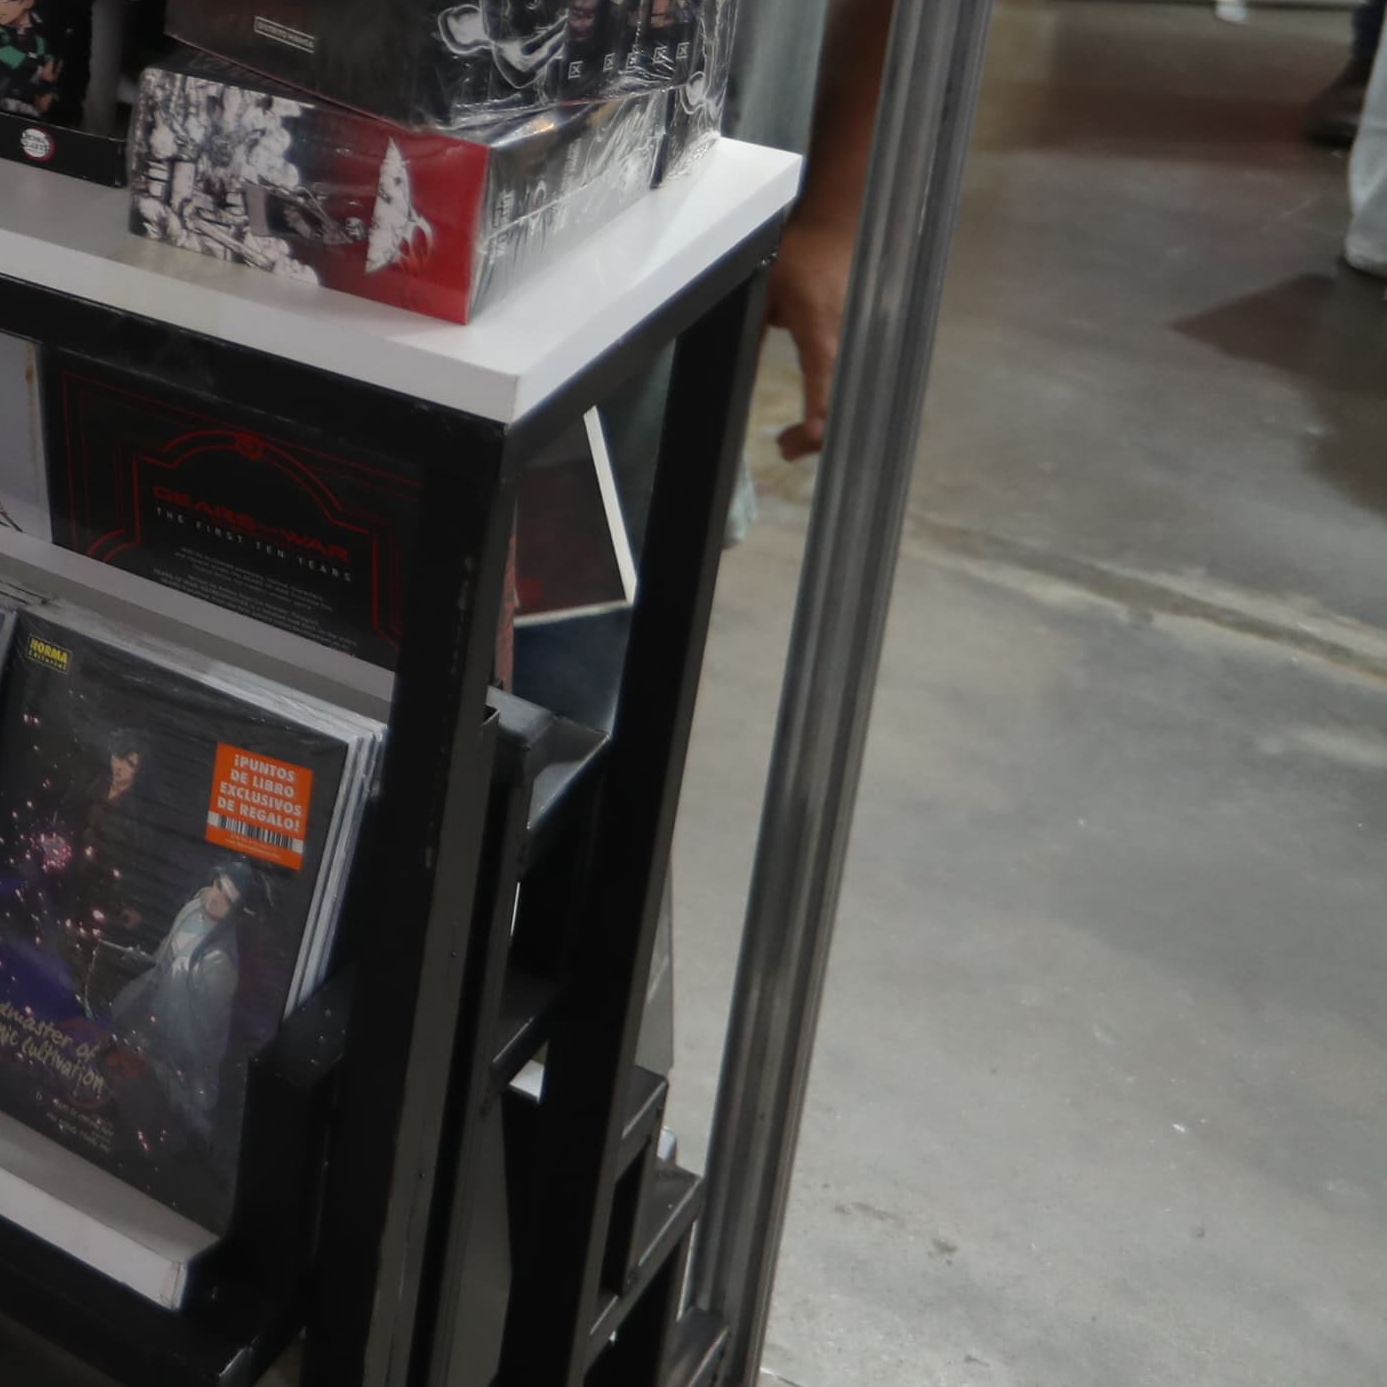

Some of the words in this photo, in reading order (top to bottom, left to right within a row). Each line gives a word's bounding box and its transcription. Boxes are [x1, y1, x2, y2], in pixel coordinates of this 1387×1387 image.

[157, 507, 184, 524] THE
[196, 521, 243, 544] FIRST
[256, 542, 286, 559] TEN
[298, 557, 352, 582] YEARS
[30, 638, 69, 666] NORMA
[230, 769, 249, 785] DE
[254, 772, 295, 799] LIBRO
[234, 753, 296, 783] ¡PUNTOS
[217, 797, 237, 813] DE
[240, 802, 301, 832] REGALO!
[219, 782, 303, 819] EXCLUSIVOS
